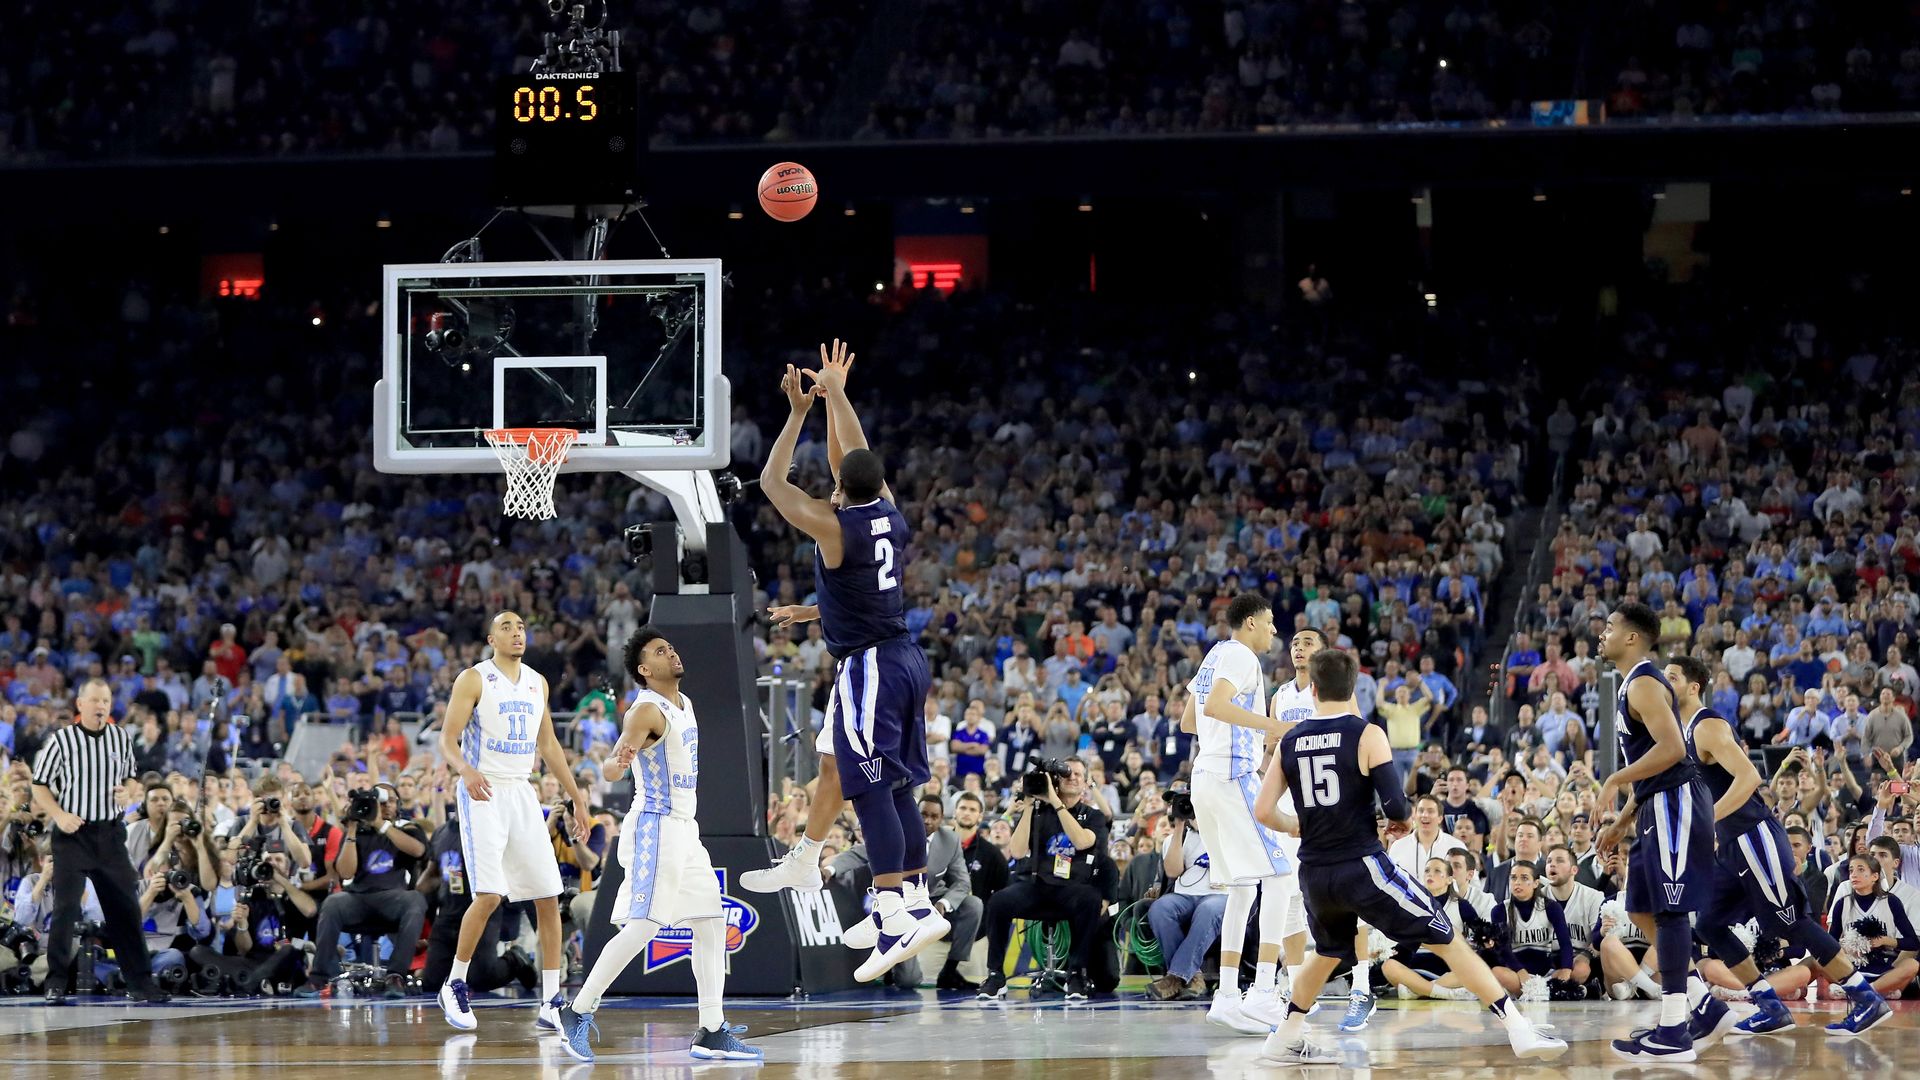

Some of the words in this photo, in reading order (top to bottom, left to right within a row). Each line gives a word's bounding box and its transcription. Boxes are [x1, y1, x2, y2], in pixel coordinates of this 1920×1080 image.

[535, 72, 600, 80] DAKTRONICS
[514, 86, 597, 122] 00.5
[776, 183, 814, 194] Wilson
[875, 538, 897, 591] 2
[498, 701, 534, 716] NORTH
[507, 714, 528, 740] 11
[486, 738, 536, 755] CAROLIN
[1294, 732, 1341, 752] ARCIDIACONO
[1297, 754, 1340, 808] 15
[790, 889, 845, 947] NCAA
[657, 929, 692, 937] OUSTON
